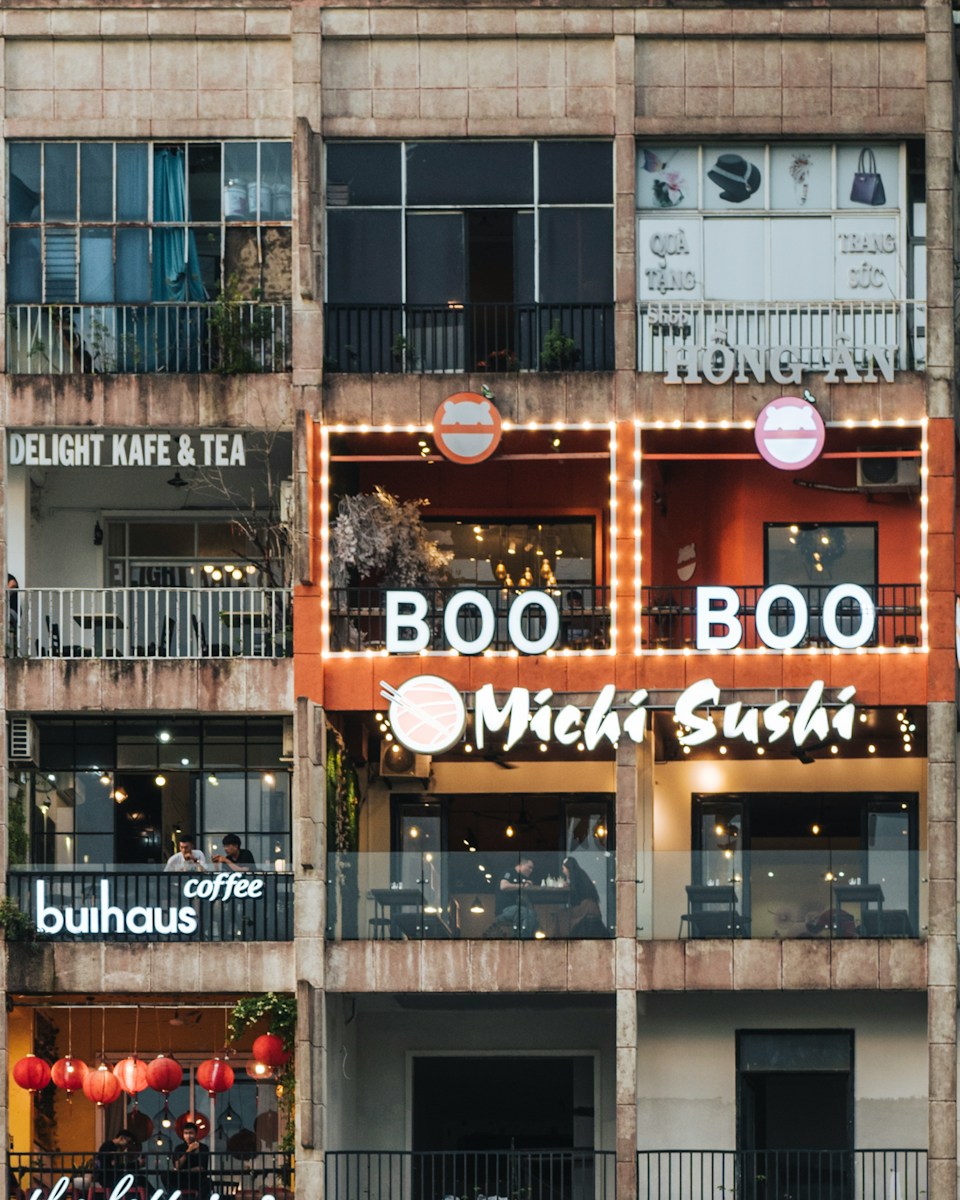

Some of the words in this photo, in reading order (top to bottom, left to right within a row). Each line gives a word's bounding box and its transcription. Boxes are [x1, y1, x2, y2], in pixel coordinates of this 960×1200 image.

[838, 233, 898, 254] TRANG
[648, 307, 690, 328] Shop
[10, 433, 104, 466] DELIGHT
[112, 433, 171, 466] KAFE
[177, 433, 195, 466] &
[200, 433, 246, 466] TEA
[385, 590, 560, 655] BOO
[696, 583, 876, 650] BOO
[475, 682, 648, 750] Michi
[675, 678, 856, 747] Sushi
[183, 872, 263, 901] coffee
